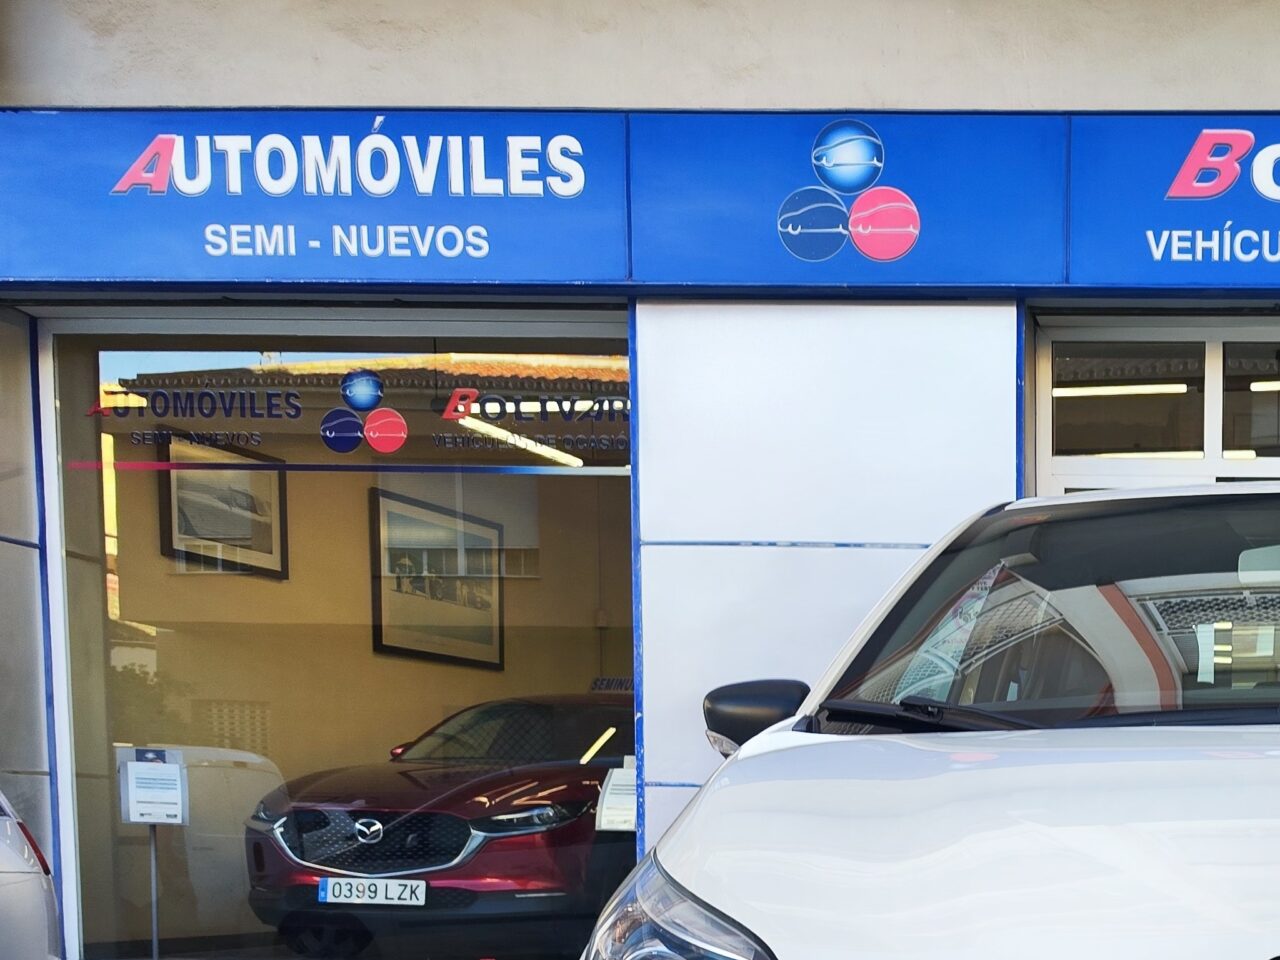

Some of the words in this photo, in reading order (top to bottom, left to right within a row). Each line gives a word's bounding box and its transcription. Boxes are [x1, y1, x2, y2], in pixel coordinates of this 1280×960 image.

[109, 115, 585, 199] AUTOMÓVILES
[203, 223, 297, 258] SEMI
[332, 224, 490, 258] NUEVOS
[332, 882, 378, 900] 0399
[384, 883, 420, 901] LZK
